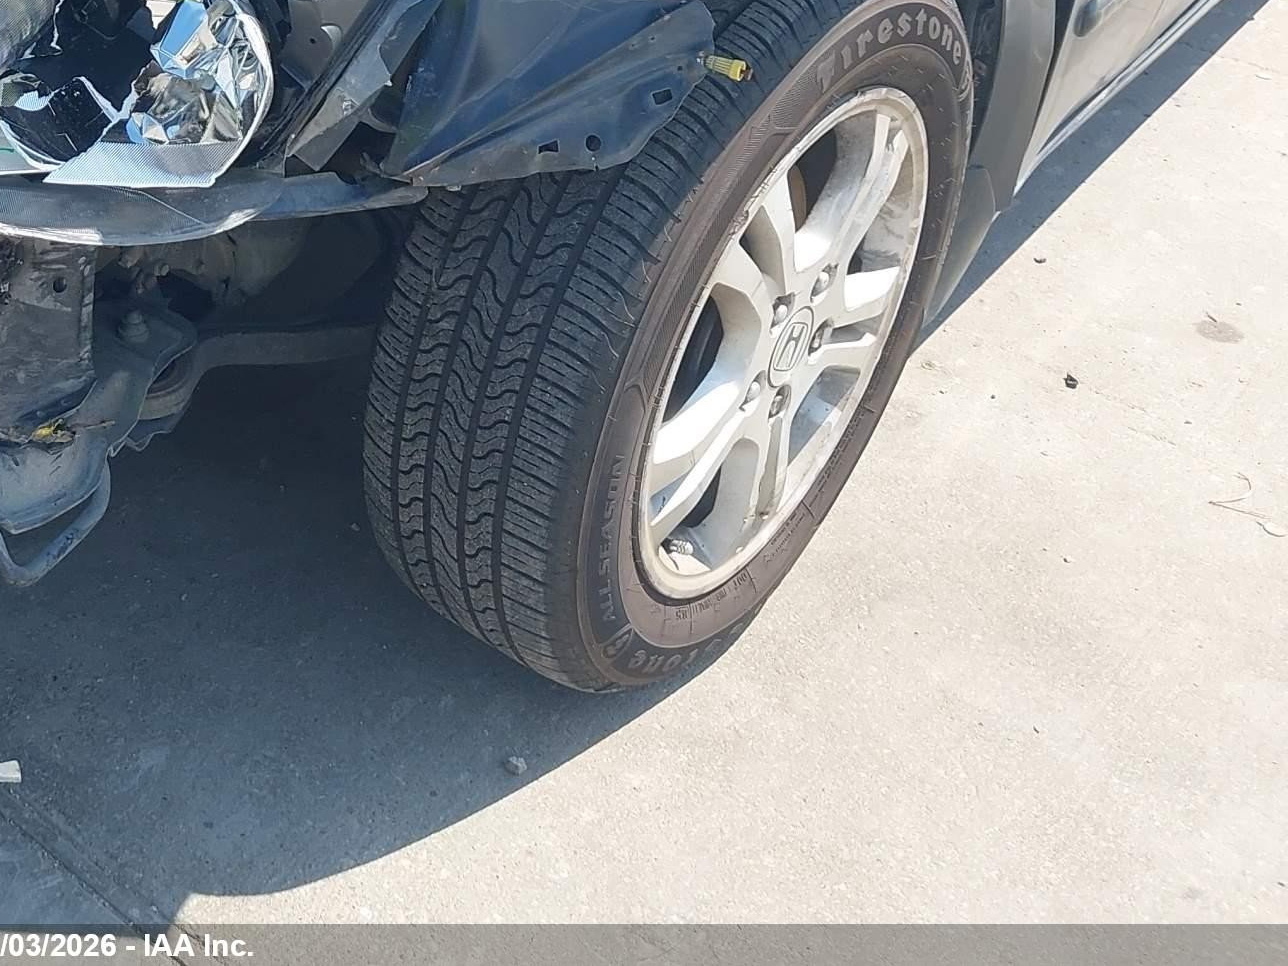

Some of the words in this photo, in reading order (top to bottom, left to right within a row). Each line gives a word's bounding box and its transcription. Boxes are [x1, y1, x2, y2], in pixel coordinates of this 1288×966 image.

[815, 8, 963, 94] Firestone
[597, 454, 625, 576] SEASON
[598, 579, 617, 622] ALL
